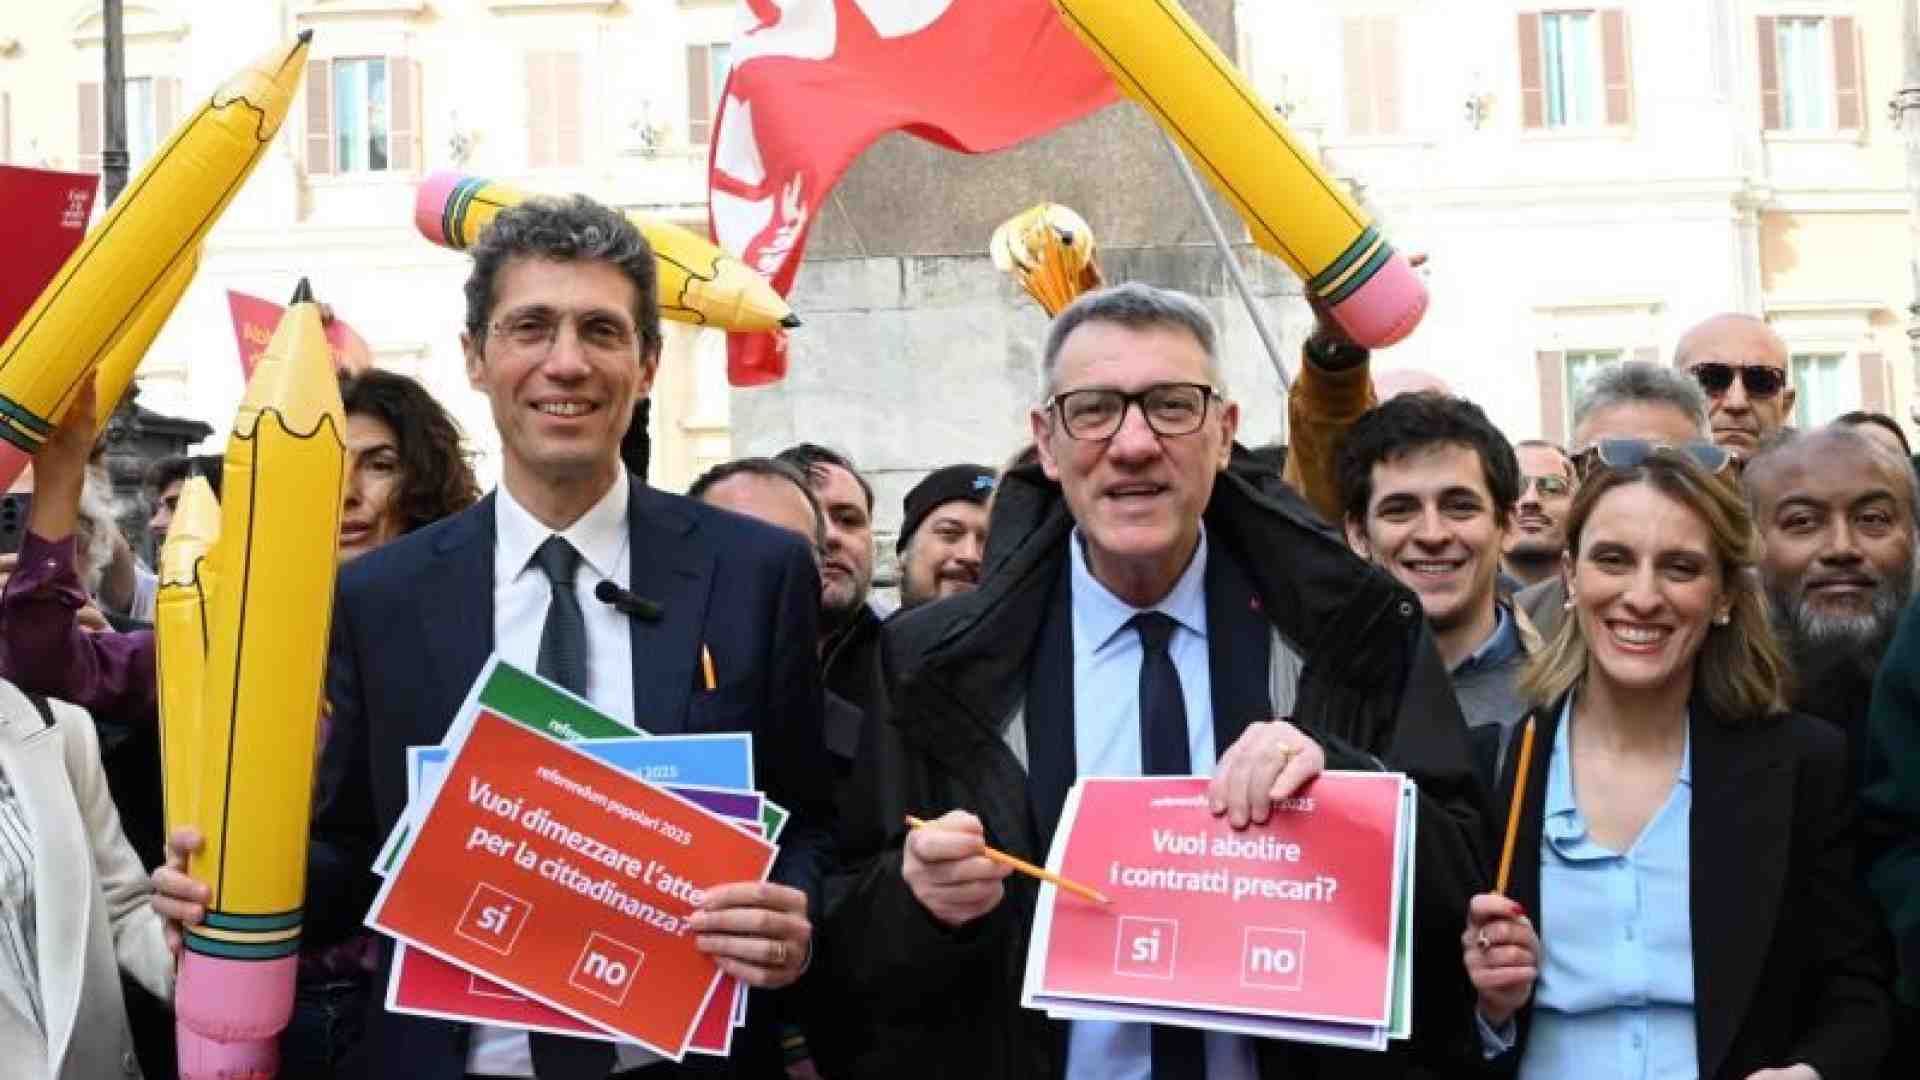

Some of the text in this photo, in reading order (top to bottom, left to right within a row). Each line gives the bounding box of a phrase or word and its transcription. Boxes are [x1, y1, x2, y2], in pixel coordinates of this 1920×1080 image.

[535, 766, 610, 807] referendum
[606, 800, 661, 832] popolari
[657, 820, 693, 846] 2025
[468, 776, 705, 909] Vuoi dimezzare l'atte
[1152, 828, 1302, 863] Vuoi abolire
[465, 826, 692, 937] per la cittadinanza?
[1109, 860, 1338, 902] i contratti precari?
[583, 949, 629, 987] no
[1250, 945, 1297, 975] no
